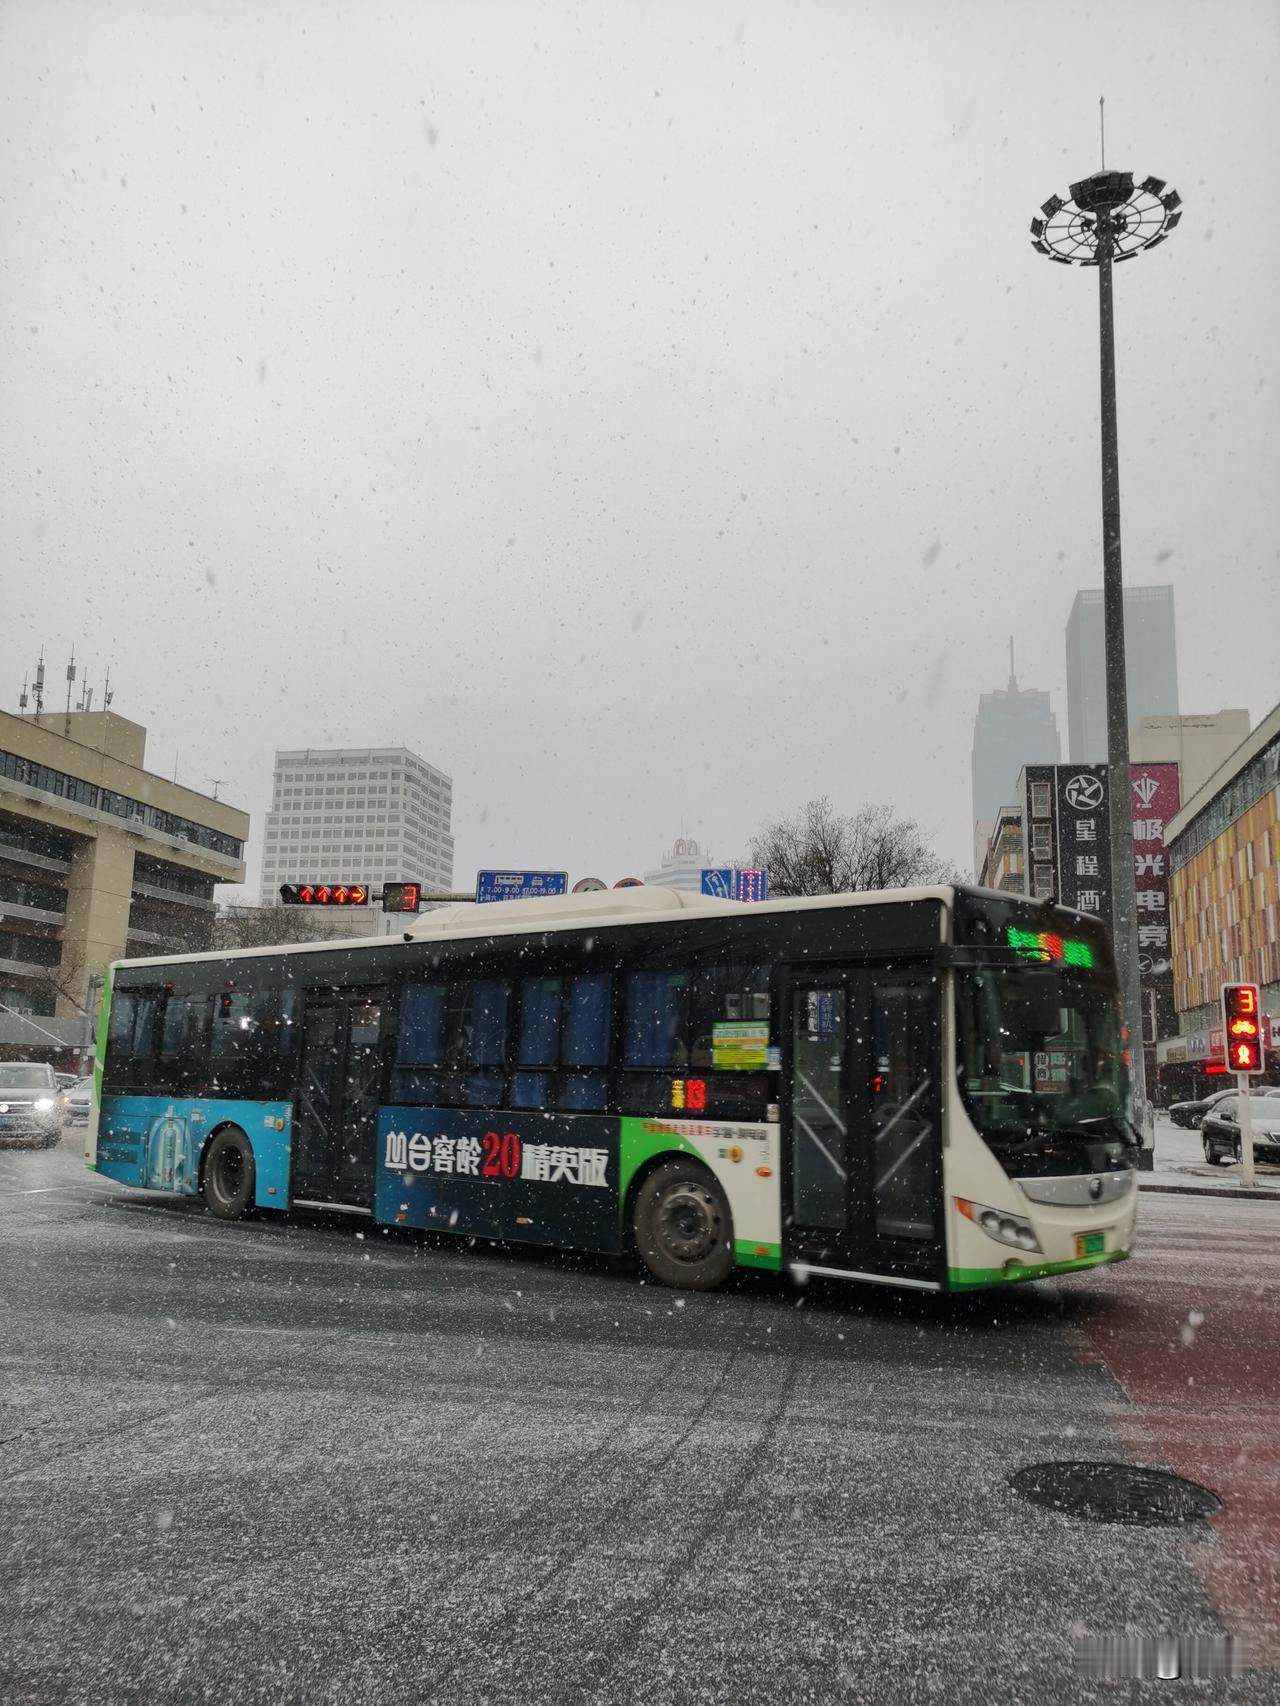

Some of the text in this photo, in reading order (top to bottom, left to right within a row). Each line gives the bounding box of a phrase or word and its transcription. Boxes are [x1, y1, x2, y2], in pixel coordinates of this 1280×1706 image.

[1132, 818, 1169, 948] 极光电竞
[403, 886, 416, 911] 3
[1240, 990, 1254, 1013] 3
